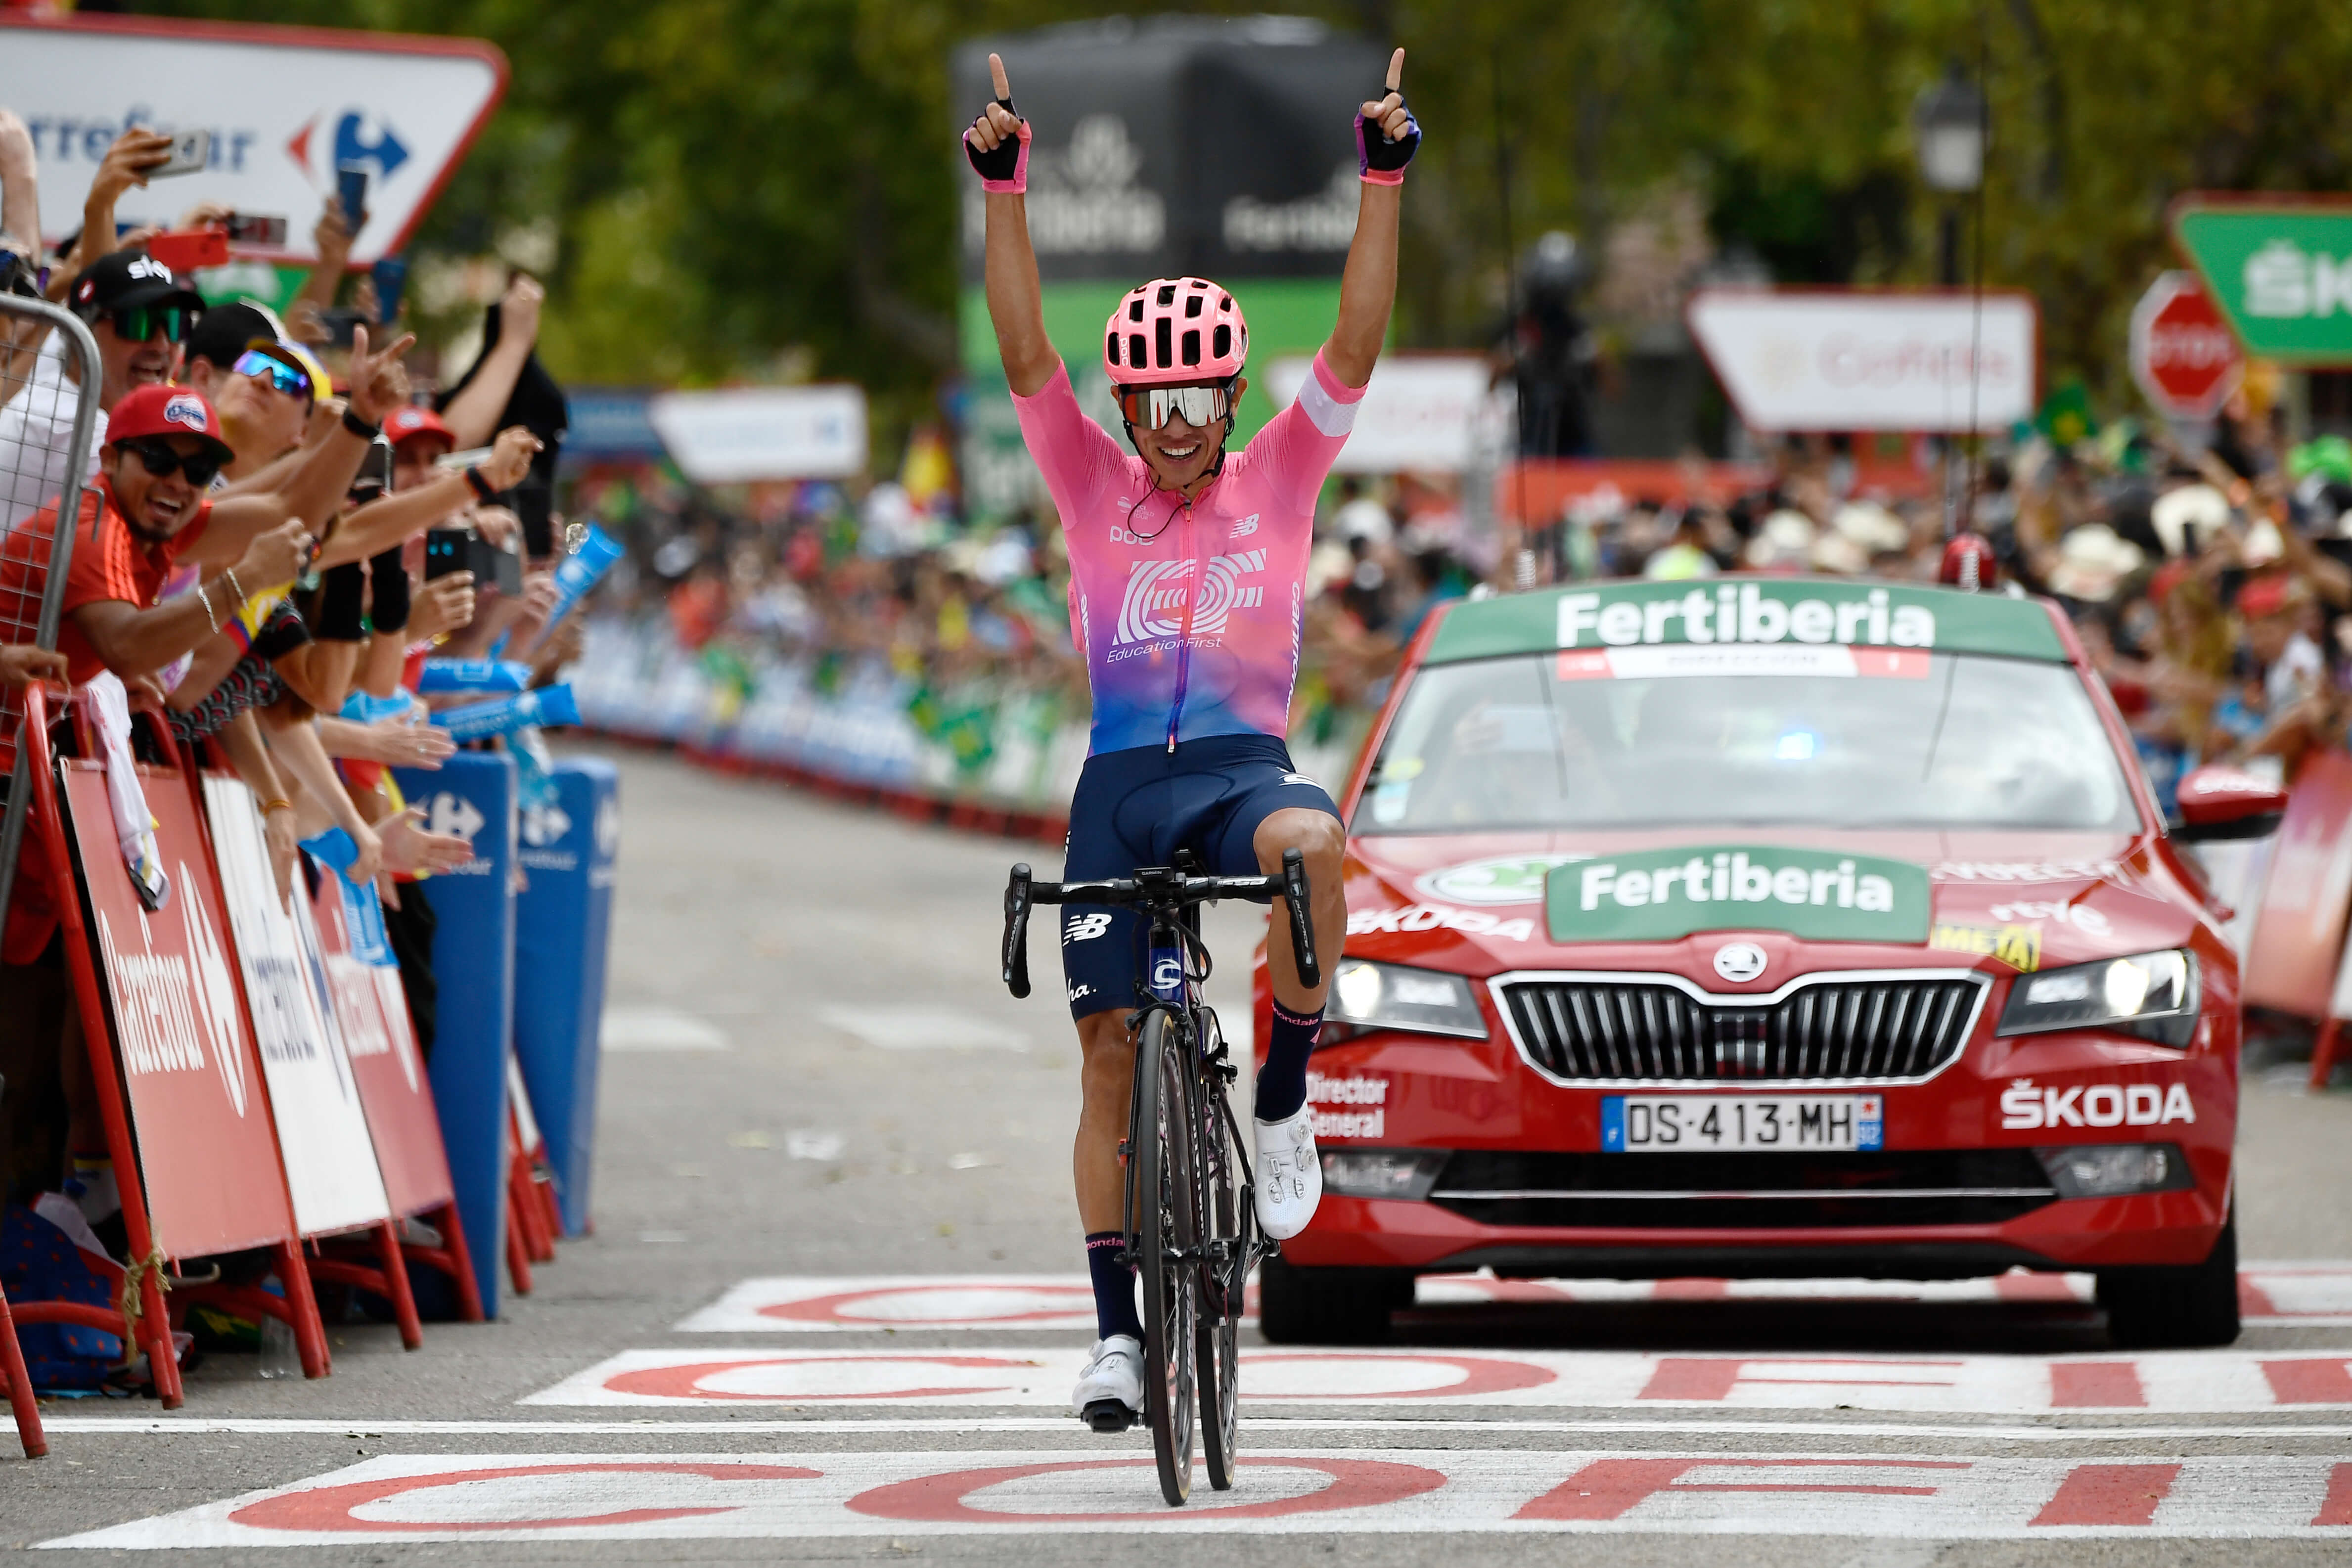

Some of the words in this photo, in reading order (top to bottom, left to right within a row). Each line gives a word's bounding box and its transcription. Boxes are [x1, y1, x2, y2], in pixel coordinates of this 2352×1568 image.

[128, 255, 173, 285] sky
[1556, 582, 1936, 648] Fertiberia
[1106, 638, 1184, 664] Education
[1185, 637, 1223, 648] First
[1580, 852, 1894, 912] Fertiberia
[100, 908, 205, 1076] Carrefour
[1306, 1070, 1390, 1104] Director
[2000, 1078, 2196, 1129] ŠKODA
[226, 1460, 2352, 1533] COFI
